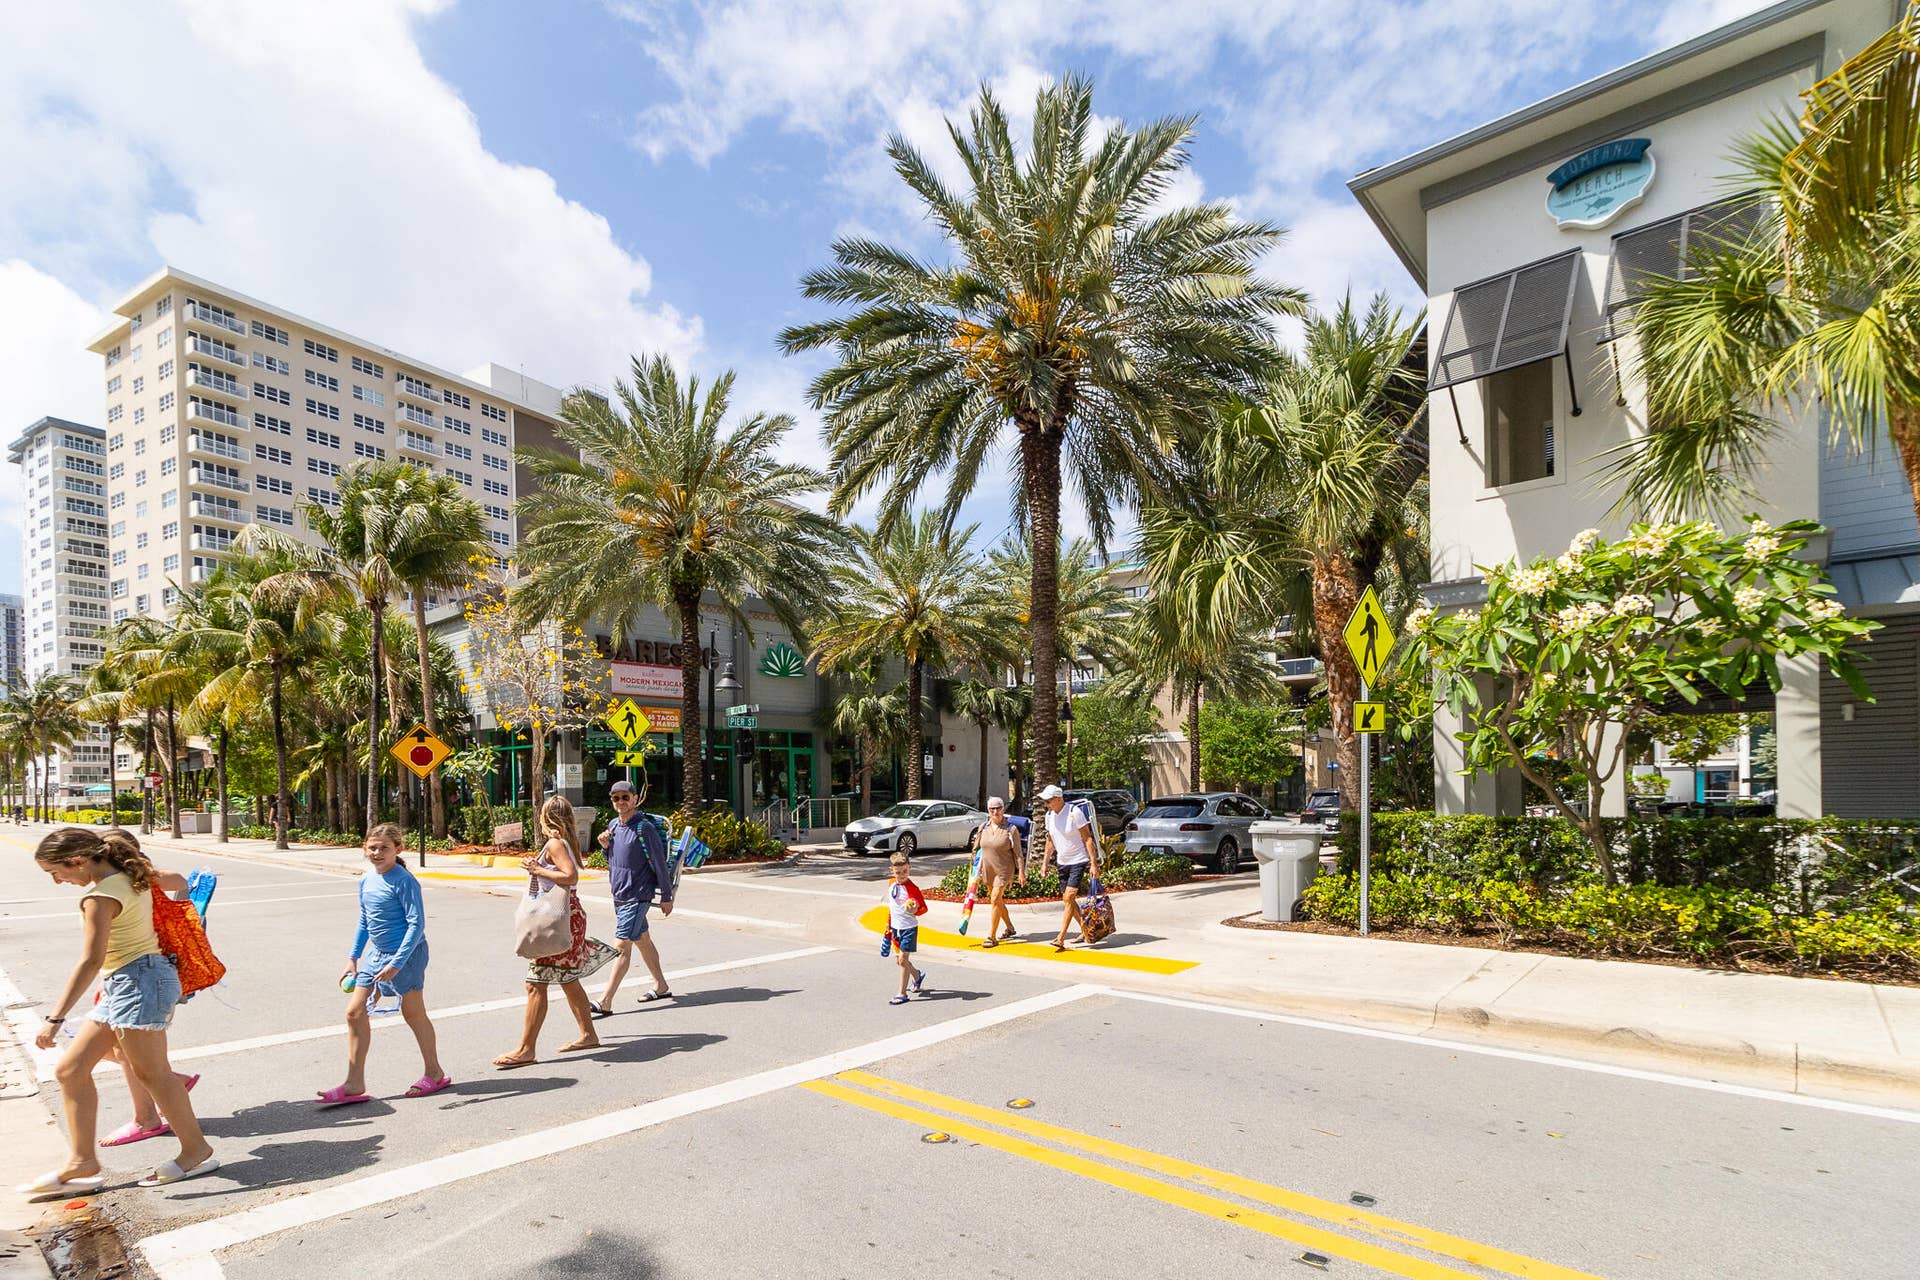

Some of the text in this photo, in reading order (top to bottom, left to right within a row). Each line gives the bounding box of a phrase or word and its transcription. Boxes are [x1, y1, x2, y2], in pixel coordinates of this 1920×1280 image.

[1561, 141, 1634, 179] POMPANO
[1575, 168, 1623, 197] BEACH
[620, 676, 650, 685] MODERN
[730, 717, 756, 727] PIER ST
